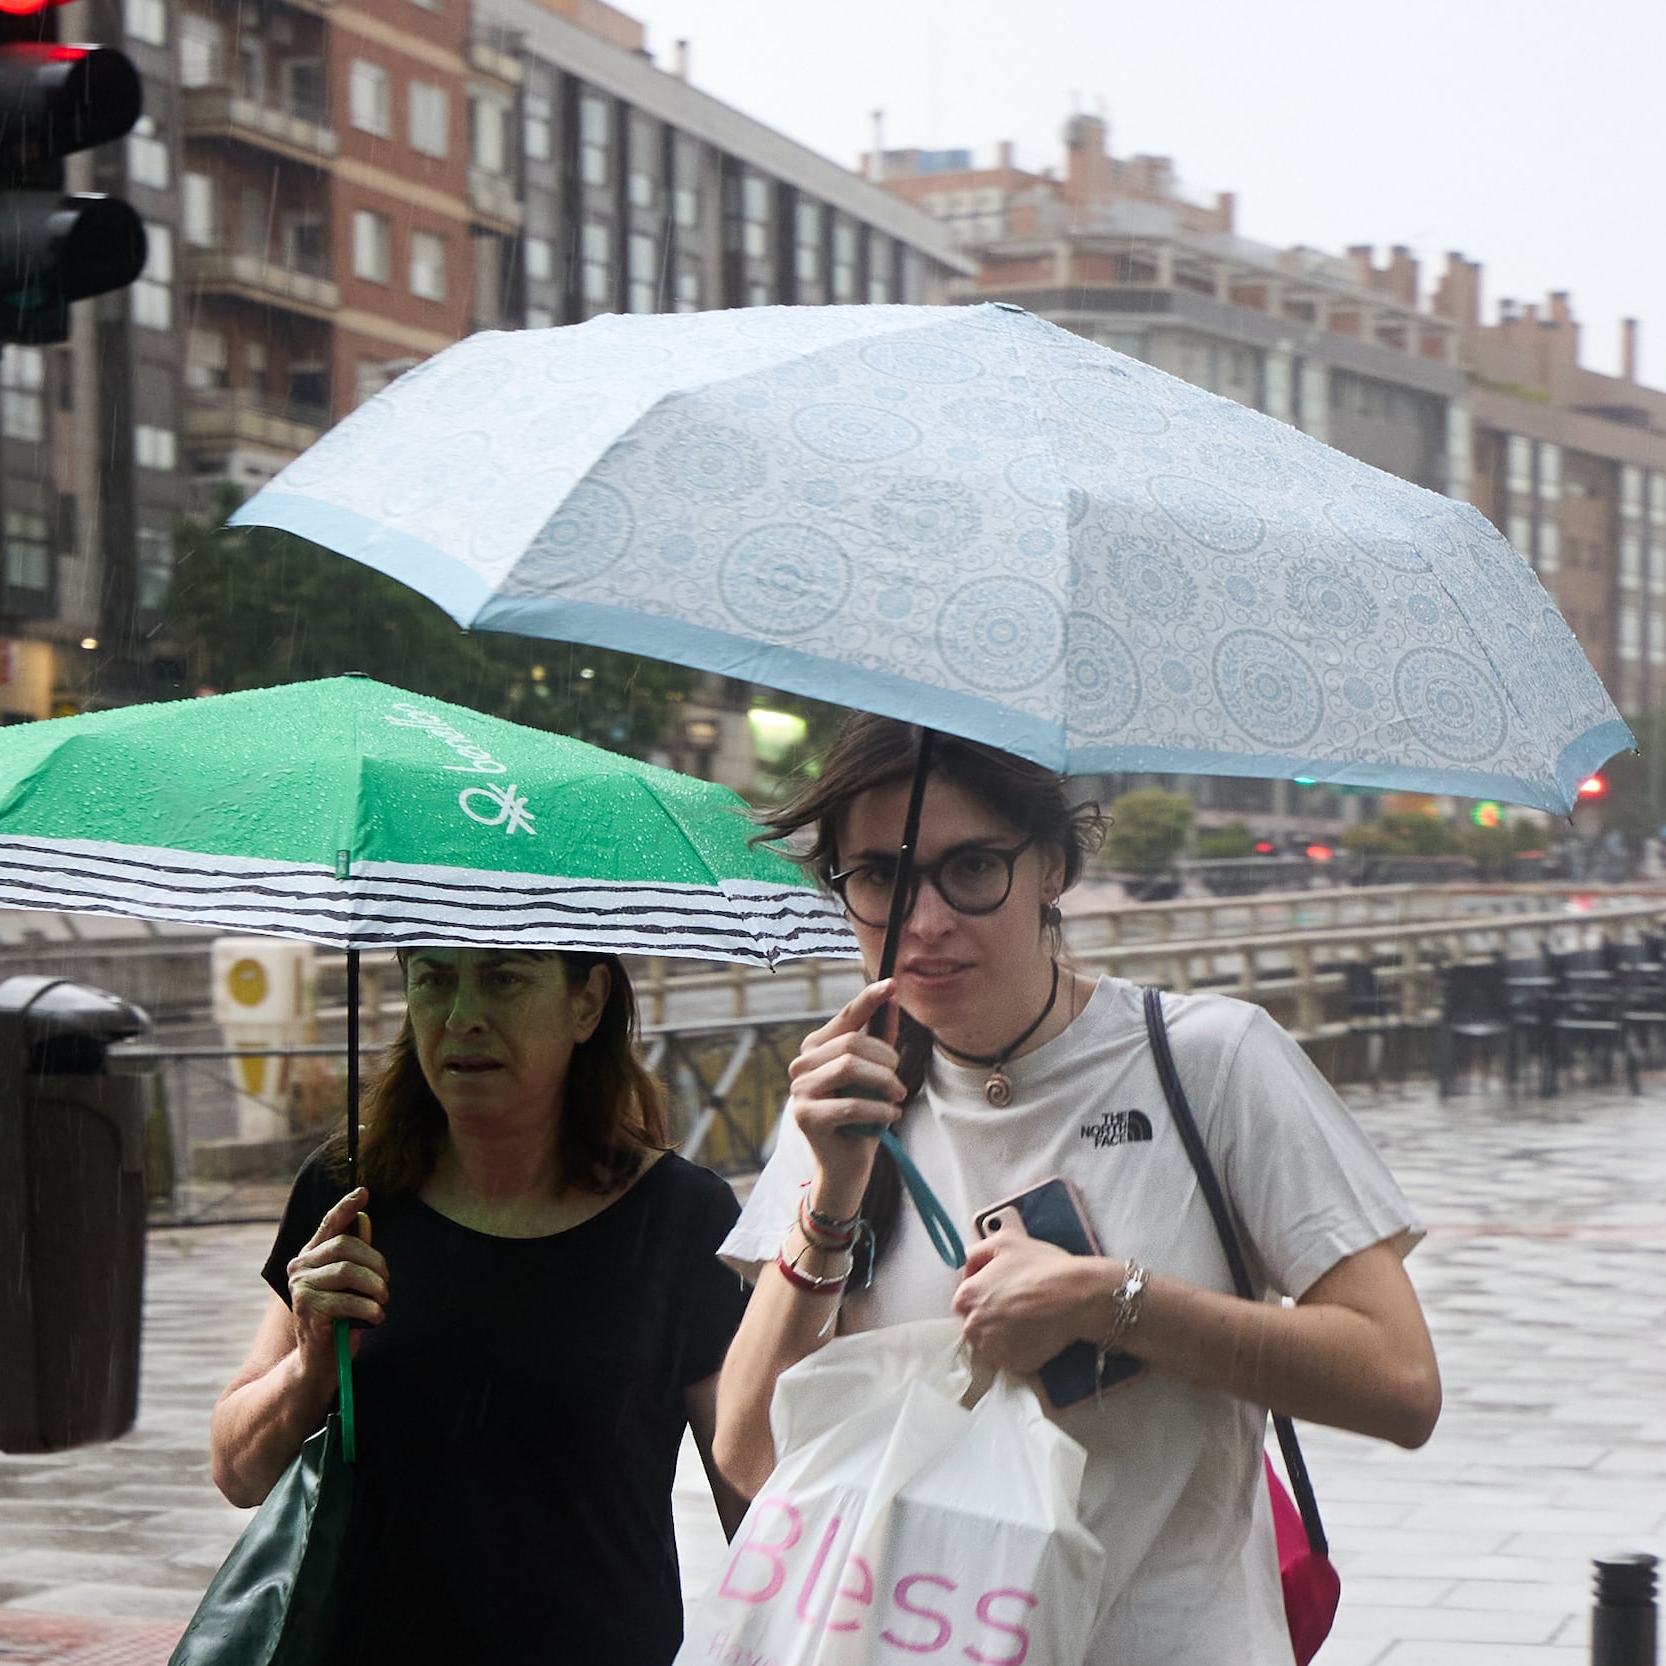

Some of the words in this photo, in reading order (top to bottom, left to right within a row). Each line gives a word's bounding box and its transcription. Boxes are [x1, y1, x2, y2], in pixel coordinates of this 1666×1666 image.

[1101, 1111, 1127, 1125] THE
[1080, 1123, 1126, 1139] NORTH
[1094, 1134, 1126, 1149] FACE
